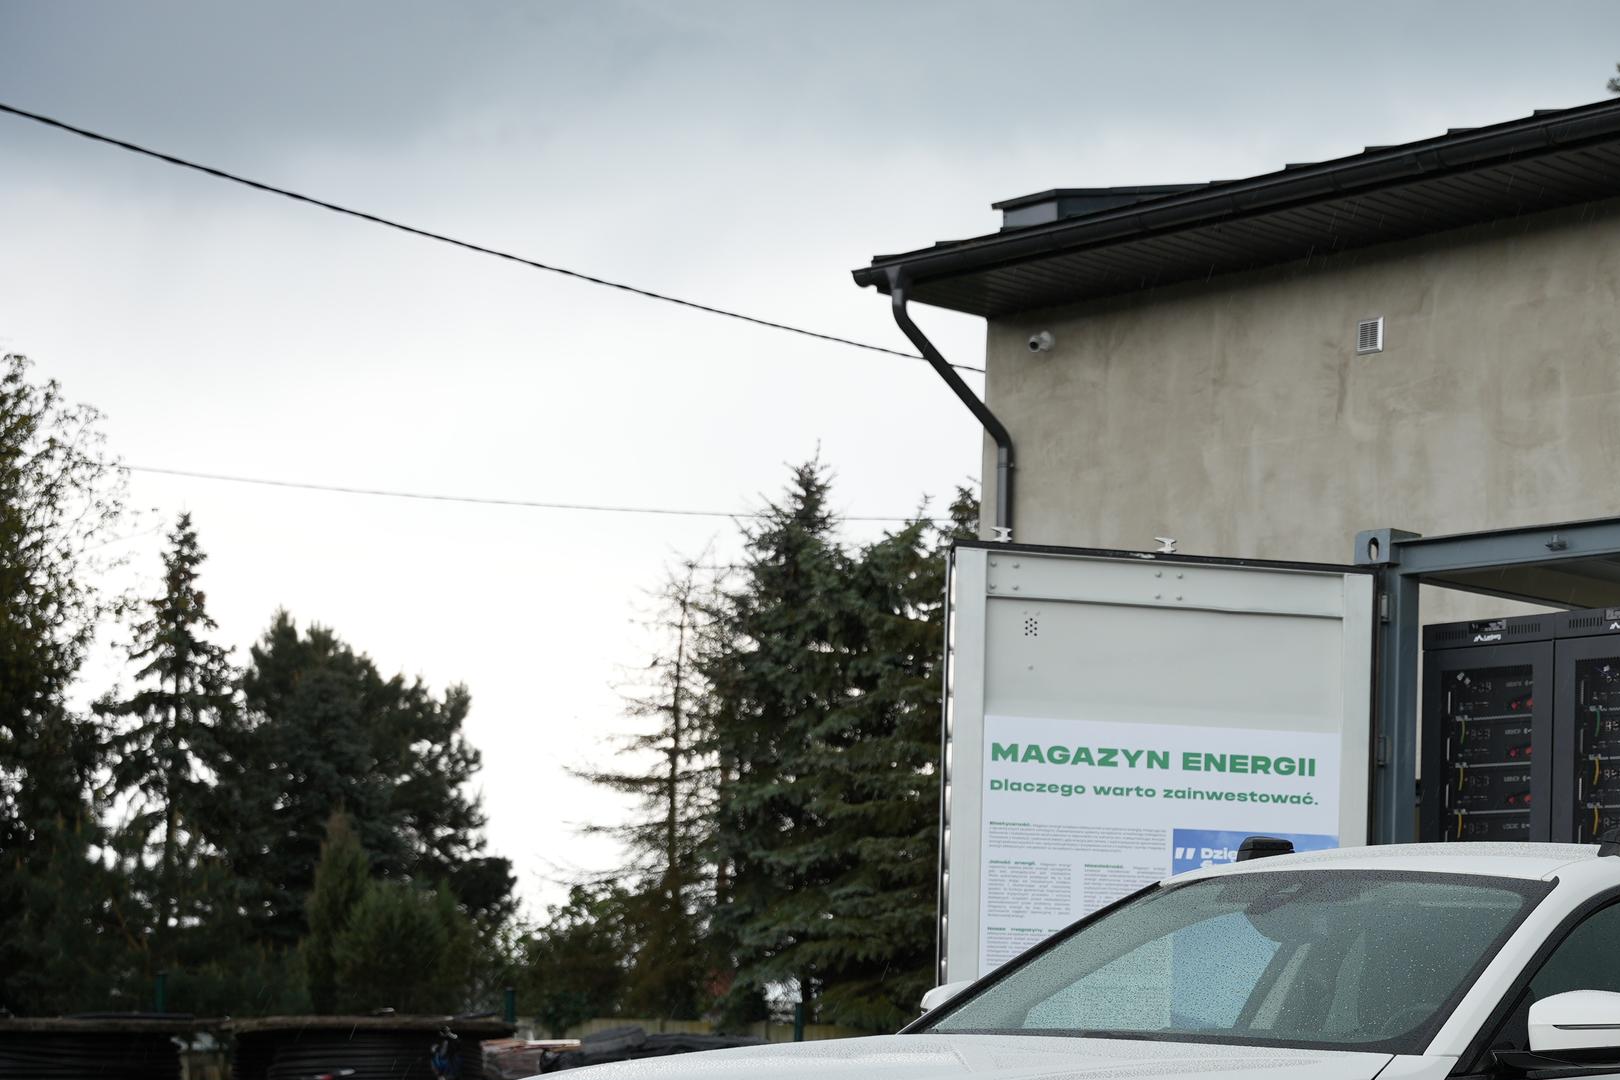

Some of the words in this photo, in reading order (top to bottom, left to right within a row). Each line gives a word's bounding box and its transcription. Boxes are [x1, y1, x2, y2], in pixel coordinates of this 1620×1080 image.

[991, 742, 1170, 770] MAGAZYN
[1182, 751, 1316, 777] ENERGII
[990, 779, 1086, 797] Dlaczego
[1093, 784, 1157, 798] warto
[1163, 787, 1319, 806] zainwestować.
